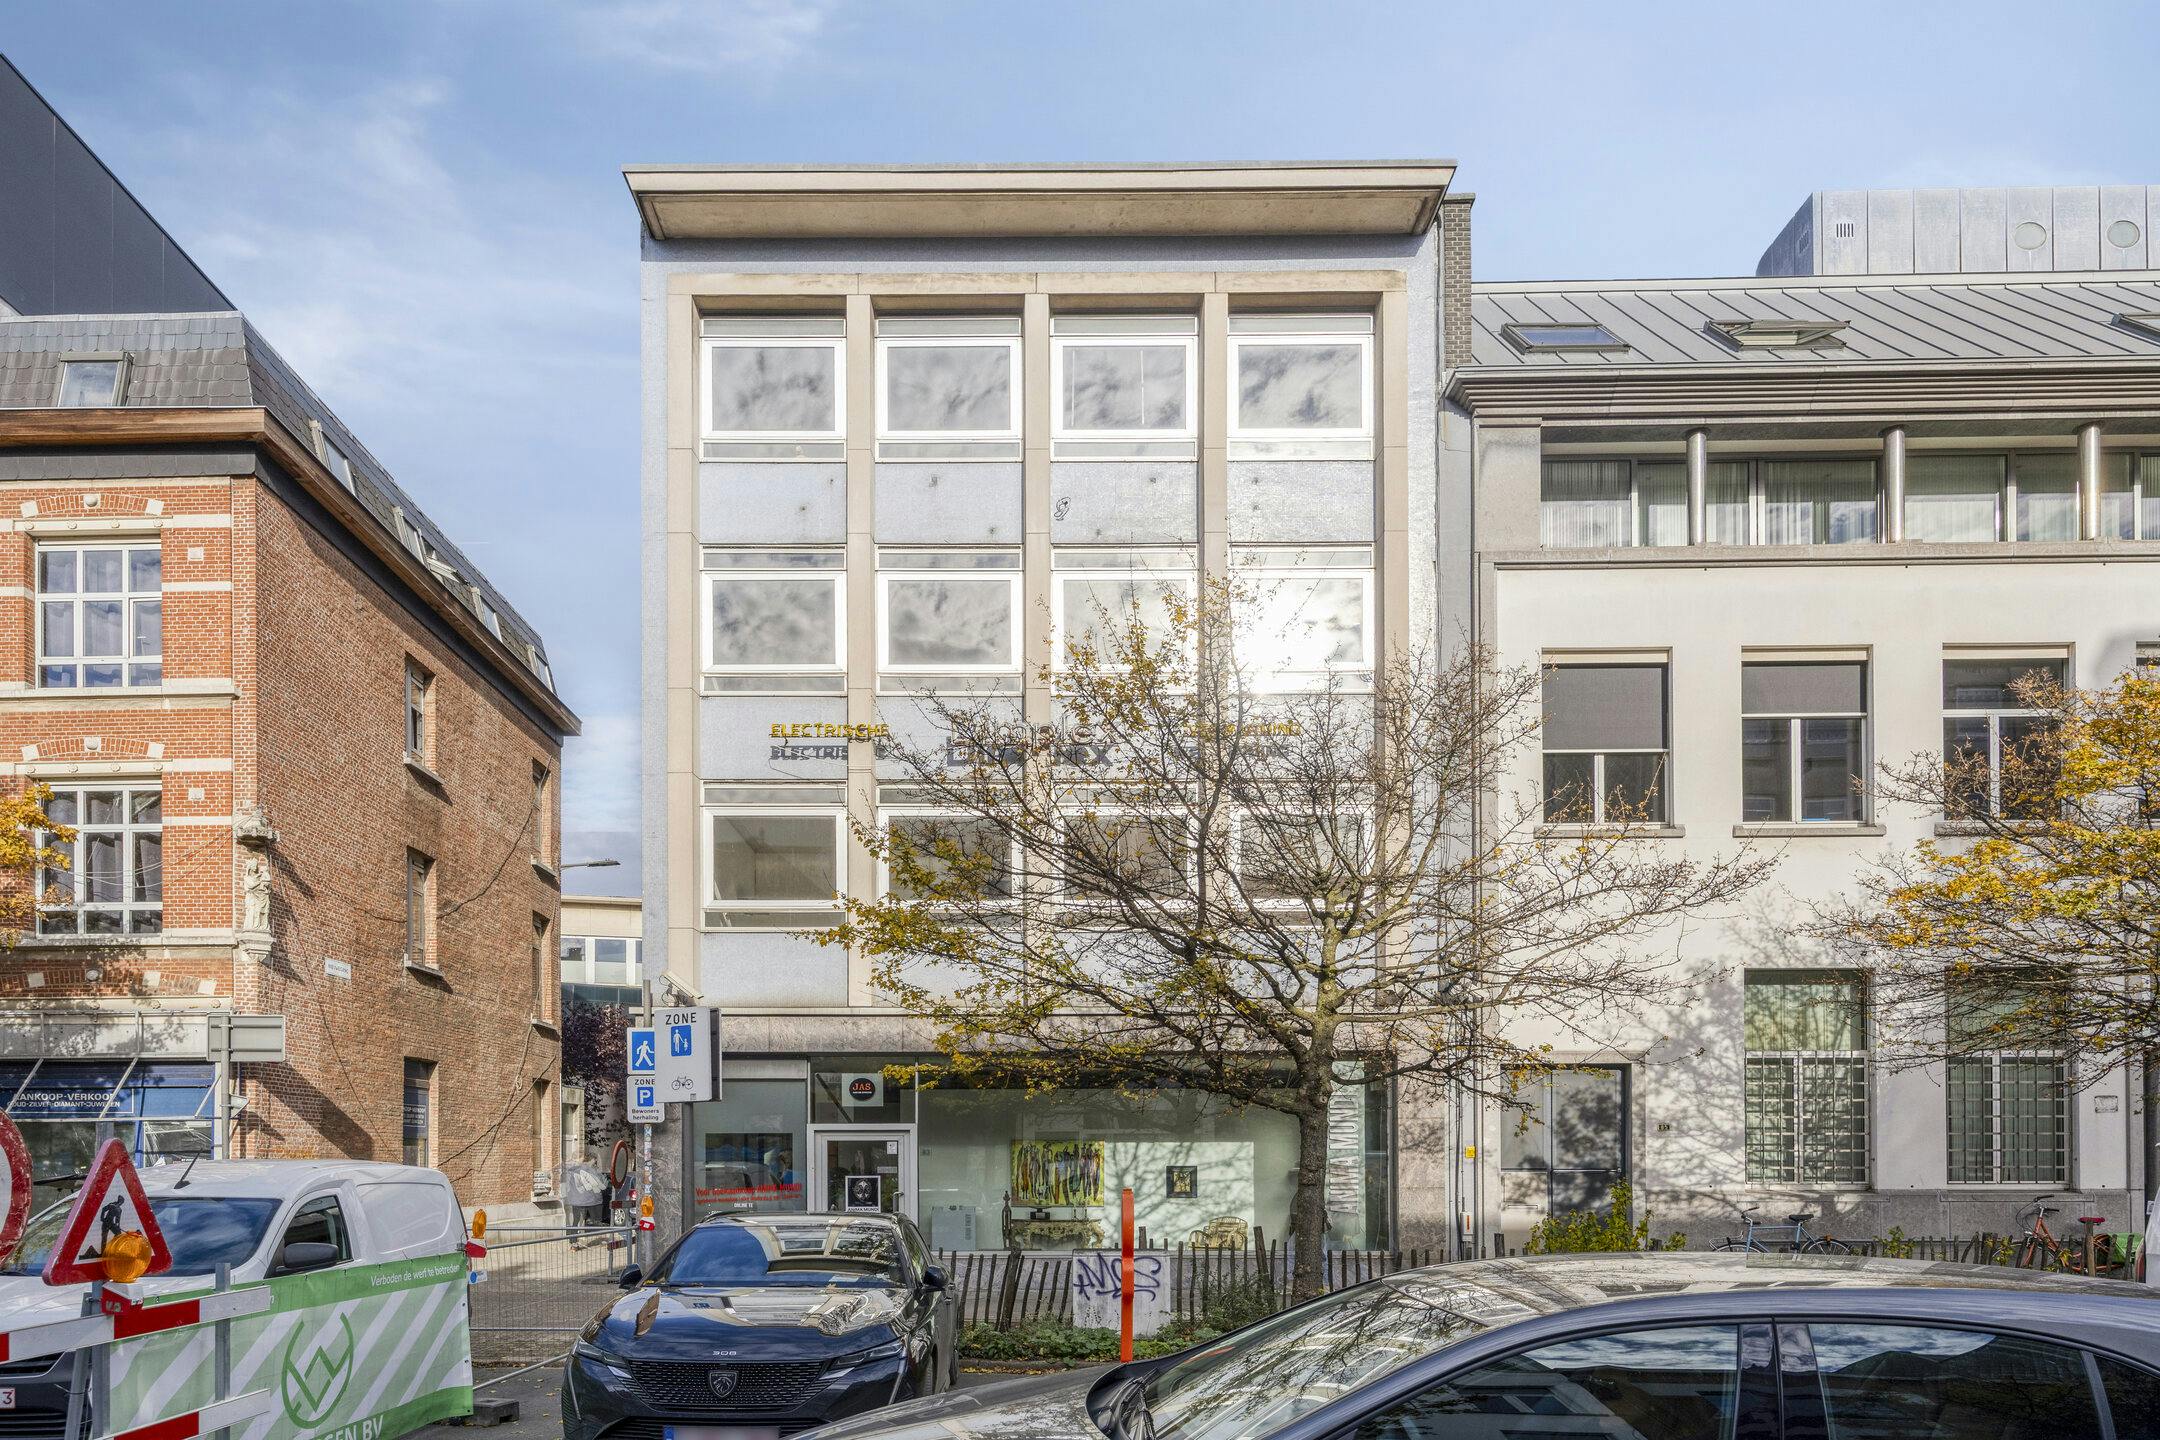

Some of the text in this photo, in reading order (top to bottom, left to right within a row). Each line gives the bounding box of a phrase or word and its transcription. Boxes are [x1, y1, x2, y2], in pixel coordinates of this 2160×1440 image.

[770, 723, 889, 738] ELECTRISCHE
[665, 1012, 697, 1025] ZONE
[634, 1078, 655, 1086] ZONE
[852, 1083, 871, 1091] JAS
[1328, 1155, 1359, 1214] ANIMA
[371, 1264, 460, 1287] Verboden de werf te betreden
[362, 1414, 384, 1440] BV
